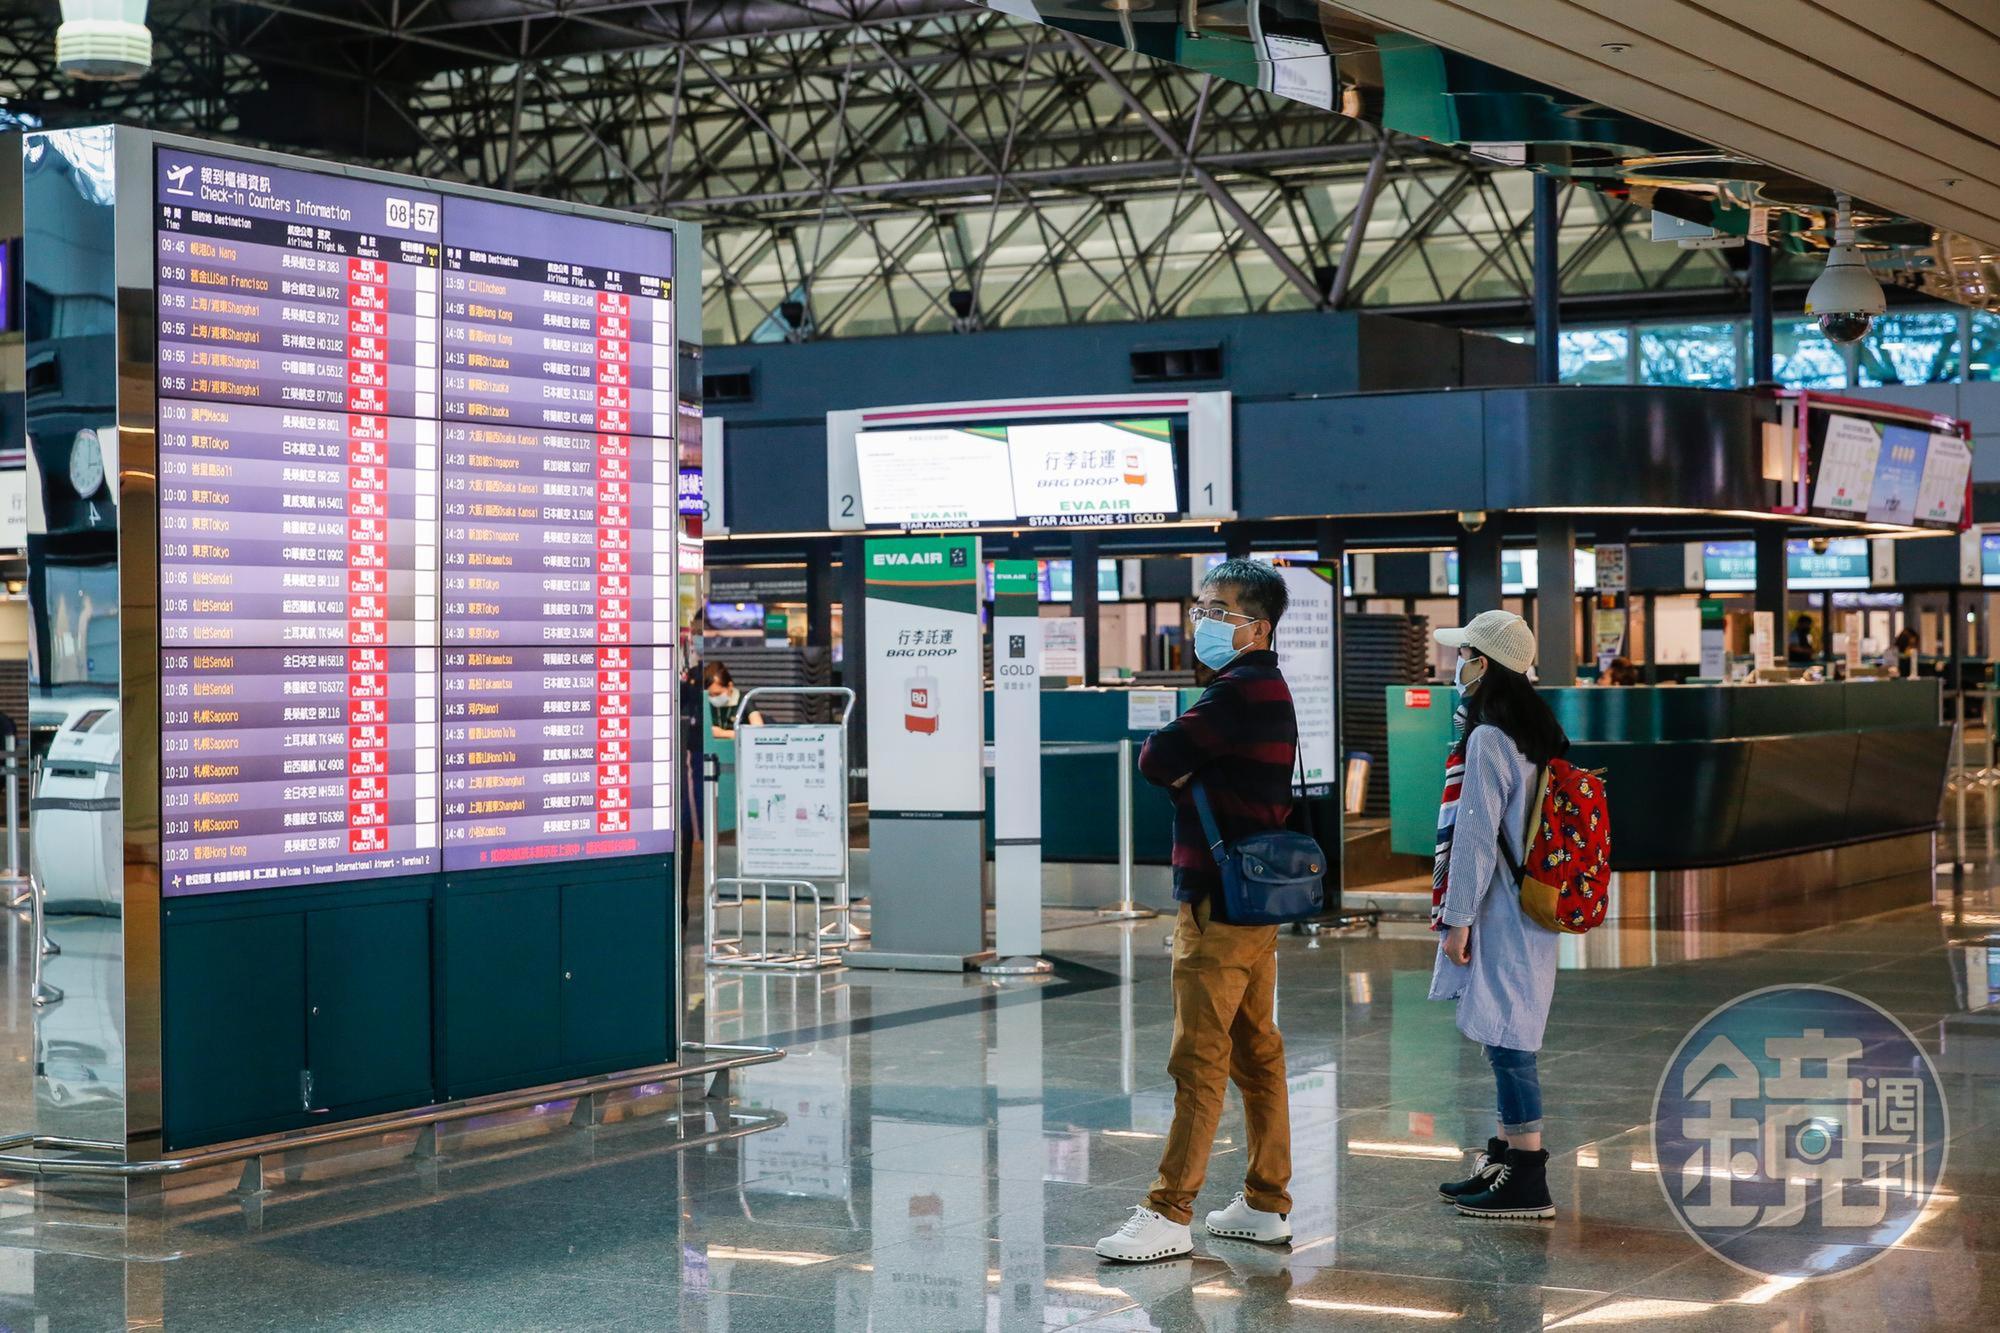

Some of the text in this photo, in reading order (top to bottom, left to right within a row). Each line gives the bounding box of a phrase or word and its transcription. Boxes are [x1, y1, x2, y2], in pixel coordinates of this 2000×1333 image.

[201, 167, 271, 193] 報到櫃檯資訊
[201, 185, 351, 221] Check-in Counters Information
[214, 215, 251, 229] Destination
[390, 205, 435, 227] 08:57
[166, 219, 180, 230] Time
[162, 239, 185, 252] 09:45
[220, 248, 236, 260] Nang
[287, 236, 313, 249] Airlines
[317, 240, 336, 252] Flight
[357, 246, 379, 258] Remarks
[402, 253, 423, 264] Counter
[162, 266, 185, 280] 09:50
[231, 276, 268, 291] Francisco
[162, 294, 185, 307] 09:55
[446, 302, 464, 314] 14:05
[498, 311, 512, 320] Kong
[162, 322, 185, 335] 09:55
[162, 350, 185, 362] 09:55
[446, 352, 464, 364] 14:15
[162, 377, 185, 390] 09:55
[164, 407, 186, 419] 10:00
[164, 434, 186, 446] 10:00
[446, 454, 464, 464] 14:20
[1045, 450, 1116, 470] 行李託運
[164, 462, 186, 474] 10:00
[1037, 477, 1119, 488] BAG DROP
[164, 489, 186, 501] 10:00
[1203, 482, 1213, 506] 1
[841, 494, 854, 517] 2
[165, 517, 186, 528] 10:00
[900, 520, 968, 530] STAR ALLIANCE
[1029, 513, 1165, 527] STAR ALLIANCE GOLD
[165, 544, 187, 556] 10:00
[446, 554, 464, 564] 14:30
[165, 572, 187, 584] 10:05
[1361, 576, 1368, 587] 7
[1691, 571, 1699, 582] 4
[166, 600, 187, 611] 10:05
[166, 627, 188, 638] 10:05
[898, 629, 954, 646] 行李託運
[886, 648, 957, 657] BAG DROP
[166, 656, 188, 668] 10:05
[446, 655, 464, 665] 14:30
[1000, 664, 1034, 676] GOLD
[166, 684, 188, 696] 10:05
[166, 712, 188, 723] 10:10
[446, 729, 464, 740] 14:35
[166, 739, 188, 751] 10:10
[446, 754, 464, 764] 14:35
[166, 766, 188, 778] 10:10
[166, 794, 188, 806] 10:10
[446, 804, 464, 814] 14:40
[166, 821, 188, 834] 10:10
[166, 849, 188, 861] 10:20
[231, 846, 247, 856] Kong
[280, 854, 430, 878] Welcome to Taoyuan International Airport Terminal 2
